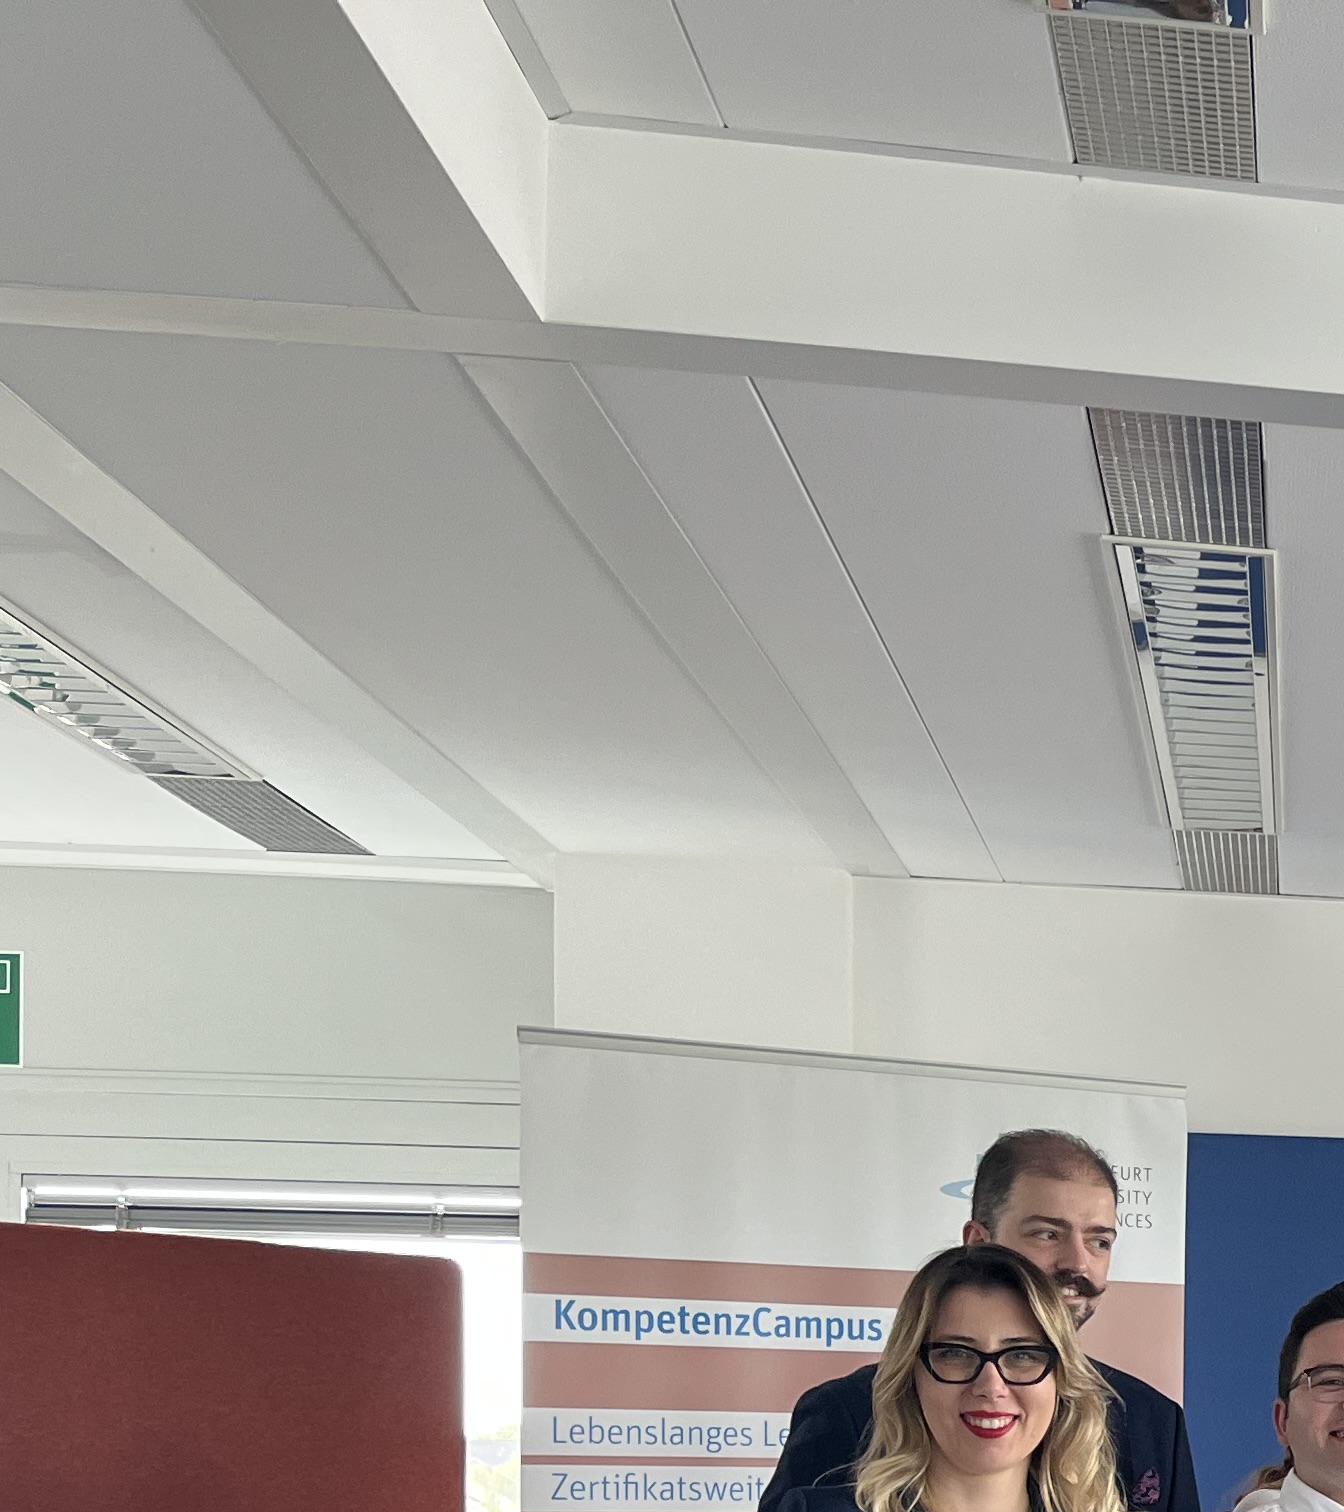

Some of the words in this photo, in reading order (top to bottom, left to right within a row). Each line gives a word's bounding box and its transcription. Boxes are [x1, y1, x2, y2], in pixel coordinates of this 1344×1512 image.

[554, 1299, 883, 1347] KompetenzCampus
[552, 1415, 753, 1453] Lebenslanges
[551, 1472, 764, 1501] Zertifikatsweit
